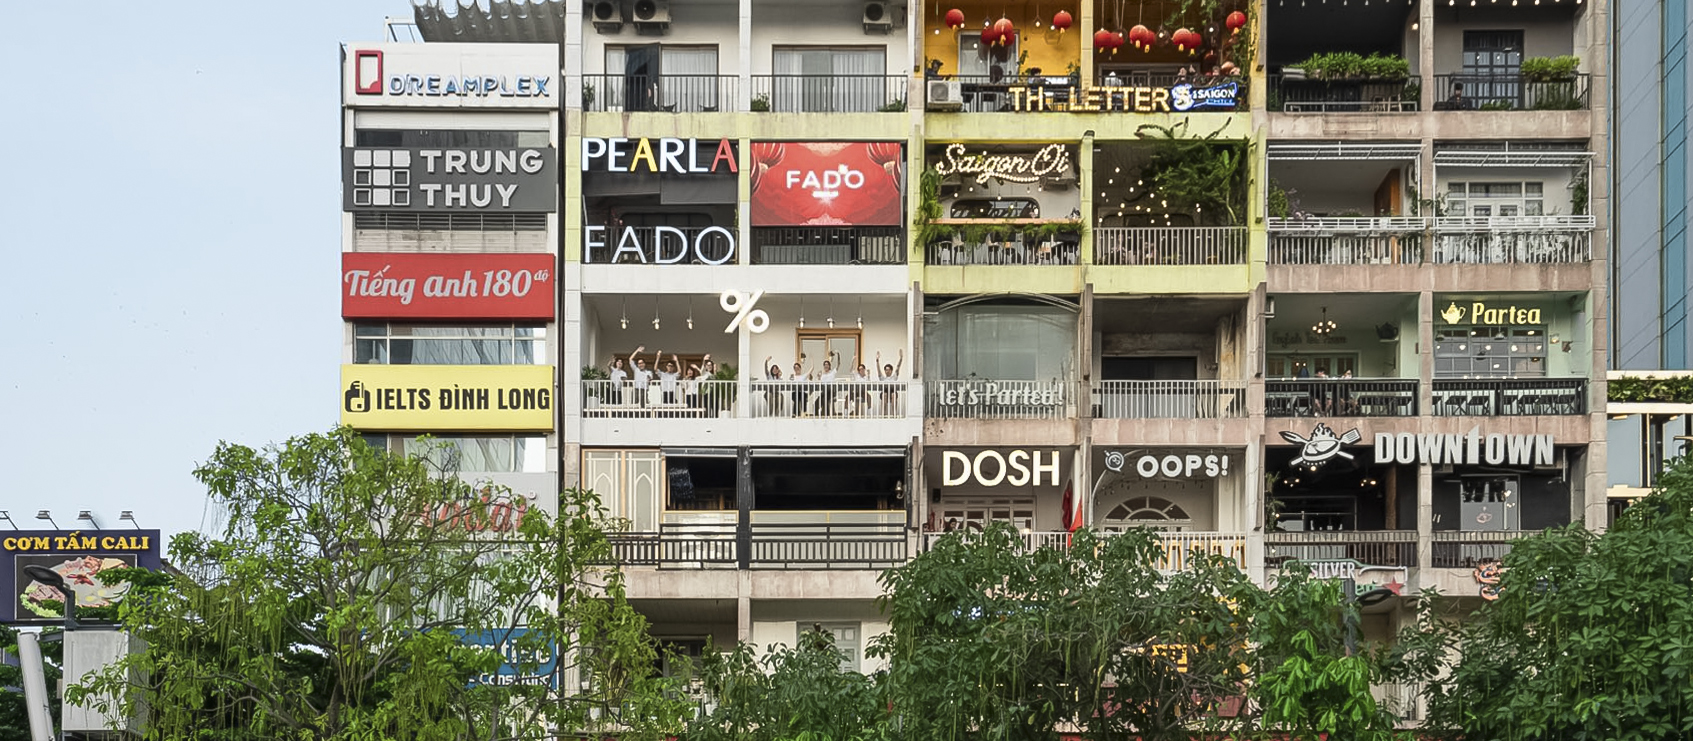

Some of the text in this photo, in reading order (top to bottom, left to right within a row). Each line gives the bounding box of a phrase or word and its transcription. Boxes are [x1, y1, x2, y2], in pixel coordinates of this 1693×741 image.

[388, 74, 550, 97] DREAMPLEX
[1069, 86, 1171, 112] LETTER
[420, 149, 544, 174] TRUNG
[582, 137, 738, 173] PEARLA
[935, 143, 1040, 184] Saigon
[786, 169, 865, 190] FADO
[420, 183, 519, 208] THUY
[584, 225, 735, 266] FADO
[344, 264, 416, 305] Tiếng
[376, 384, 550, 410] IELTS ĐÌNH LONG
[943, 450, 1060, 487] DOSH
[1136, 454, 1229, 478] OOPS!
[3, 530, 149, 551] CƠM TẤM CALI
[1310, 561, 1355, 579] SILVER
